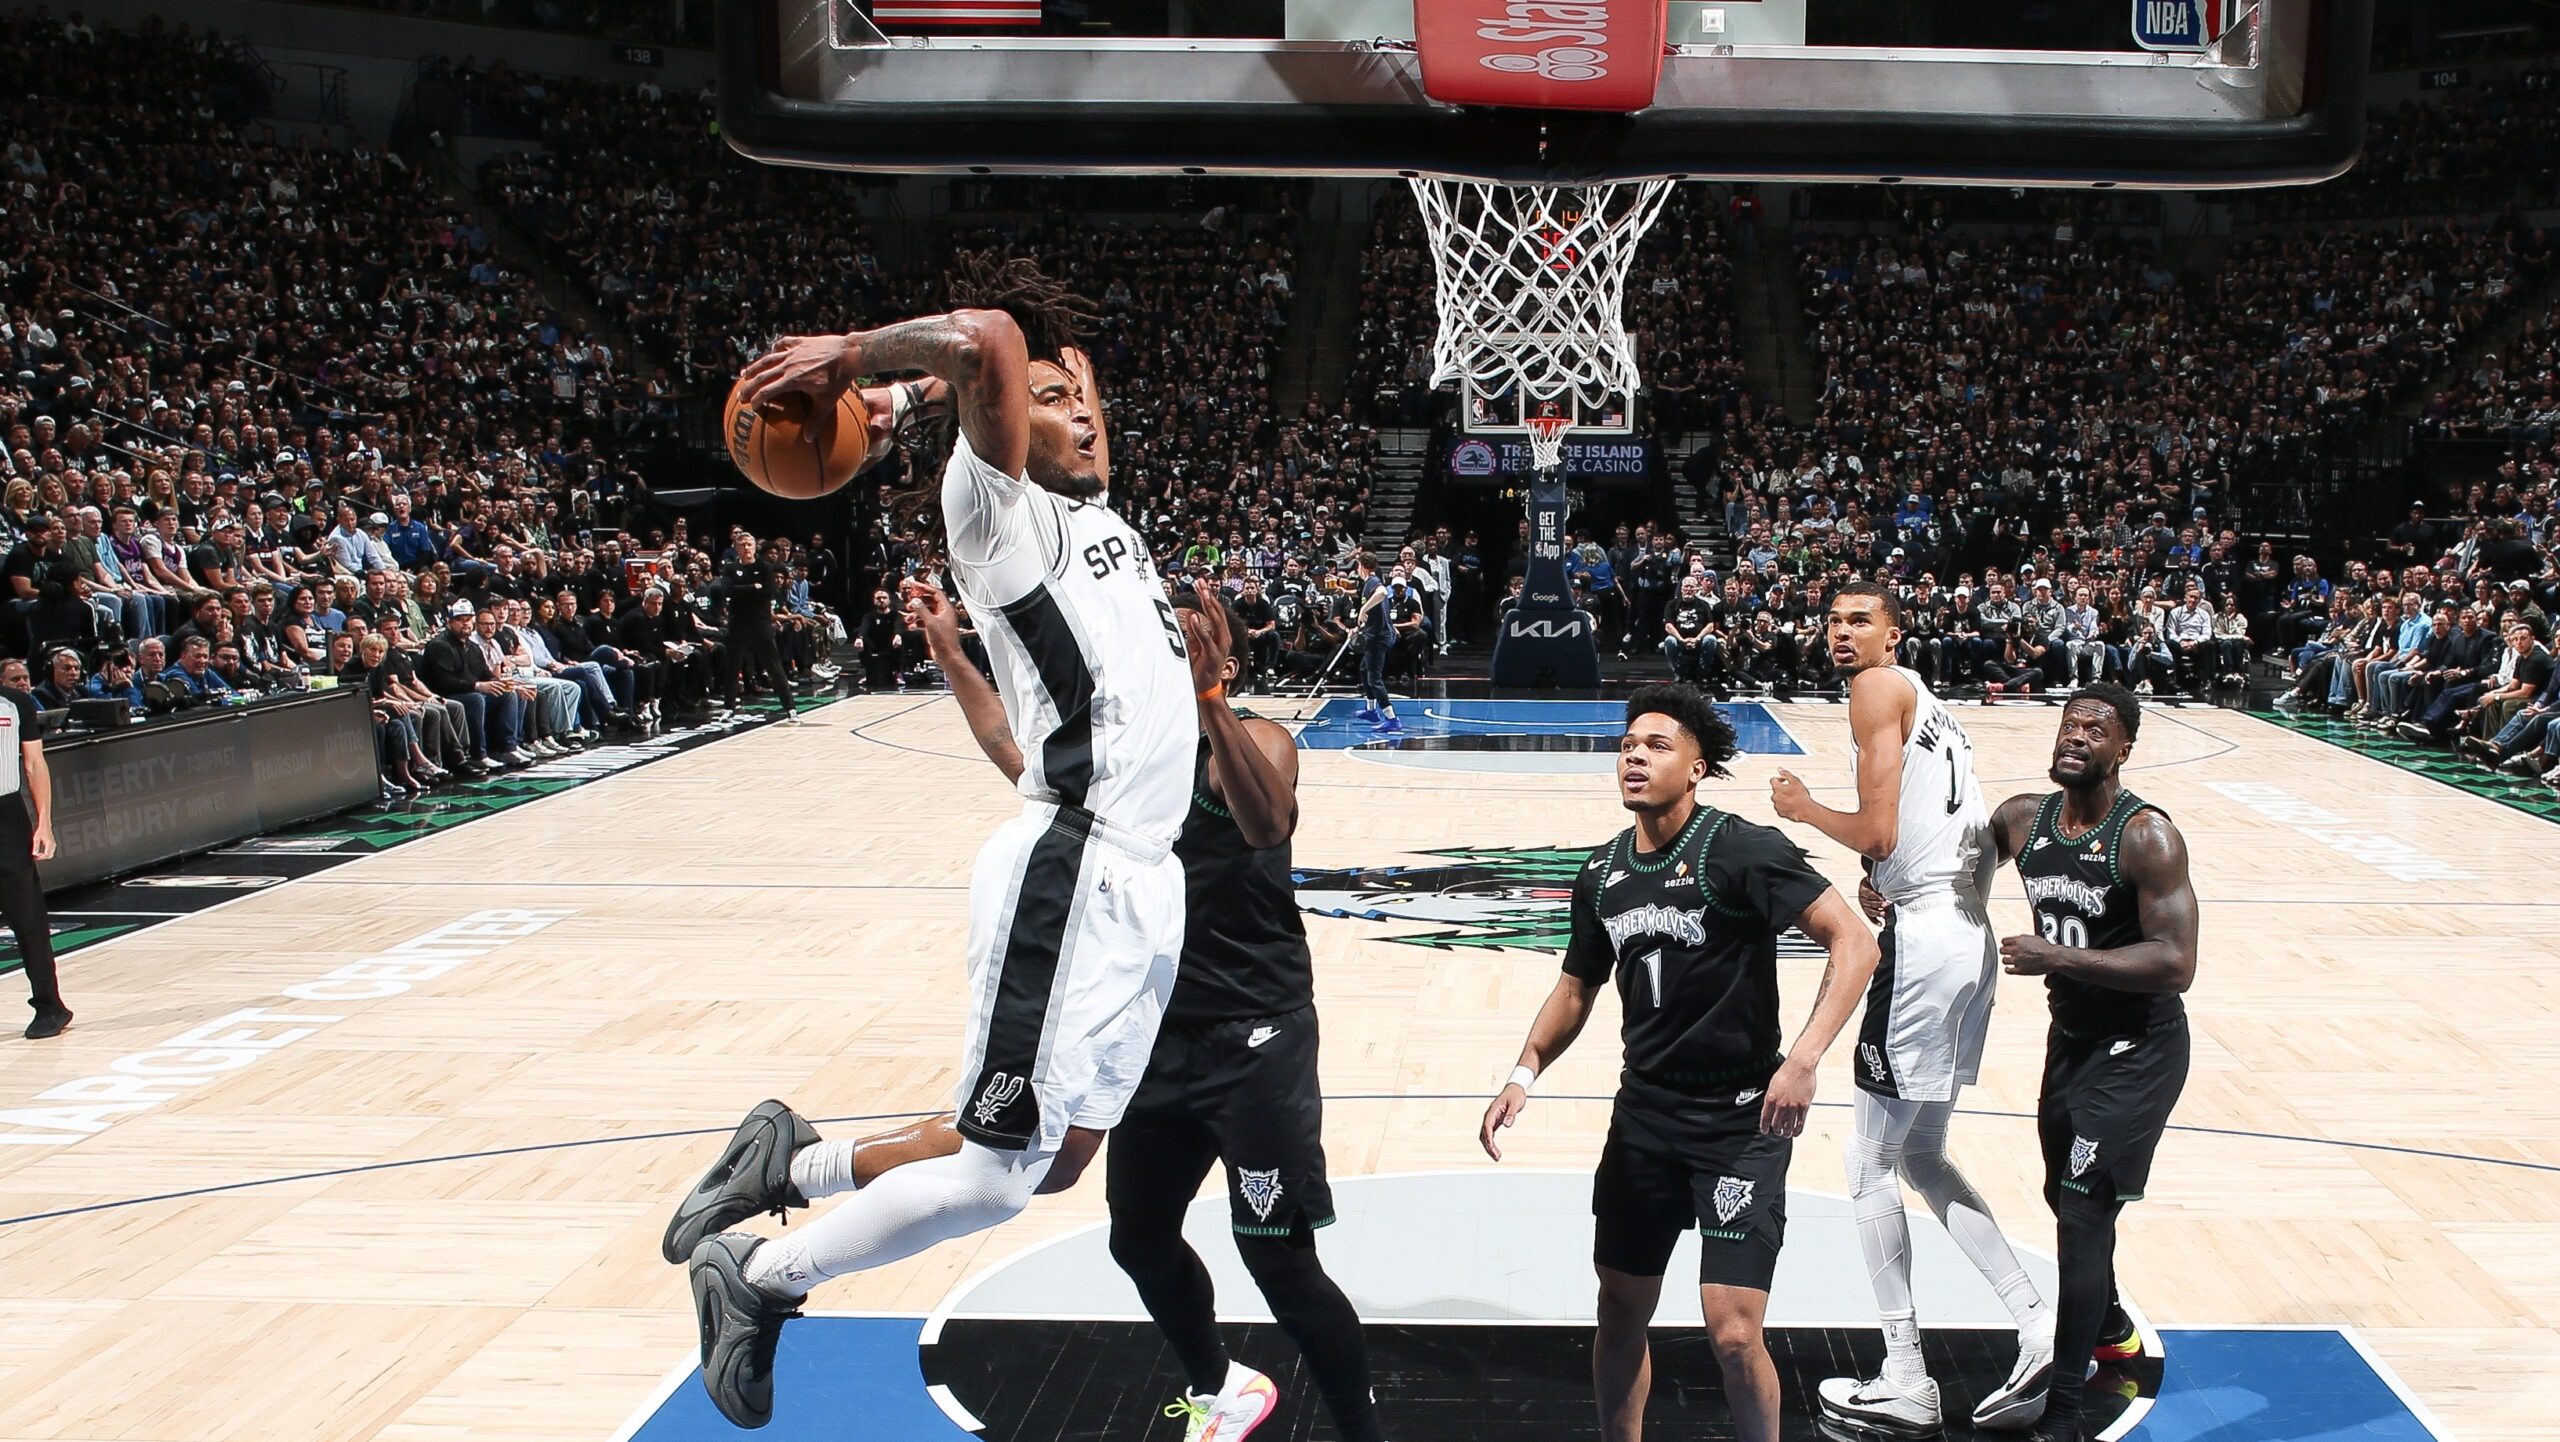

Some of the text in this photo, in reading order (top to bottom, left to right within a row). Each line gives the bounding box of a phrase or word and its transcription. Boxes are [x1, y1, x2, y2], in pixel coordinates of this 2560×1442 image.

[1476, 0, 1610, 45] Sta
[2145, 1, 2189, 35] NBA
[625, 48, 651, 64] 138
[2433, 71, 2458, 87] 104
[1586, 445, 1643, 459] ISLAND
[1566, 459, 1577, 472] &
[1582, 458, 1643, 473] CASINO
[1538, 511, 1556, 527] GET
[1538, 526, 1556, 541] THE
[1543, 542, 1560, 560] App
[1531, 592, 1559, 604] Google
[1510, 619, 1581, 638] KIA
[252, 749, 313, 784] THURSDAY
[55, 753, 177, 808] LIBERTY
[56, 797, 181, 859] ERCURY
[2079, 851, 2107, 863] sezzle
[1664, 874, 1695, 888] sezzle
[2023, 873, 2112, 918] TIMBERWOLVES
[1601, 902, 1708, 961] TIMBERWOLVES
[281, 907, 582, 1001] CENTER
[1640, 948, 1662, 1008] 1
